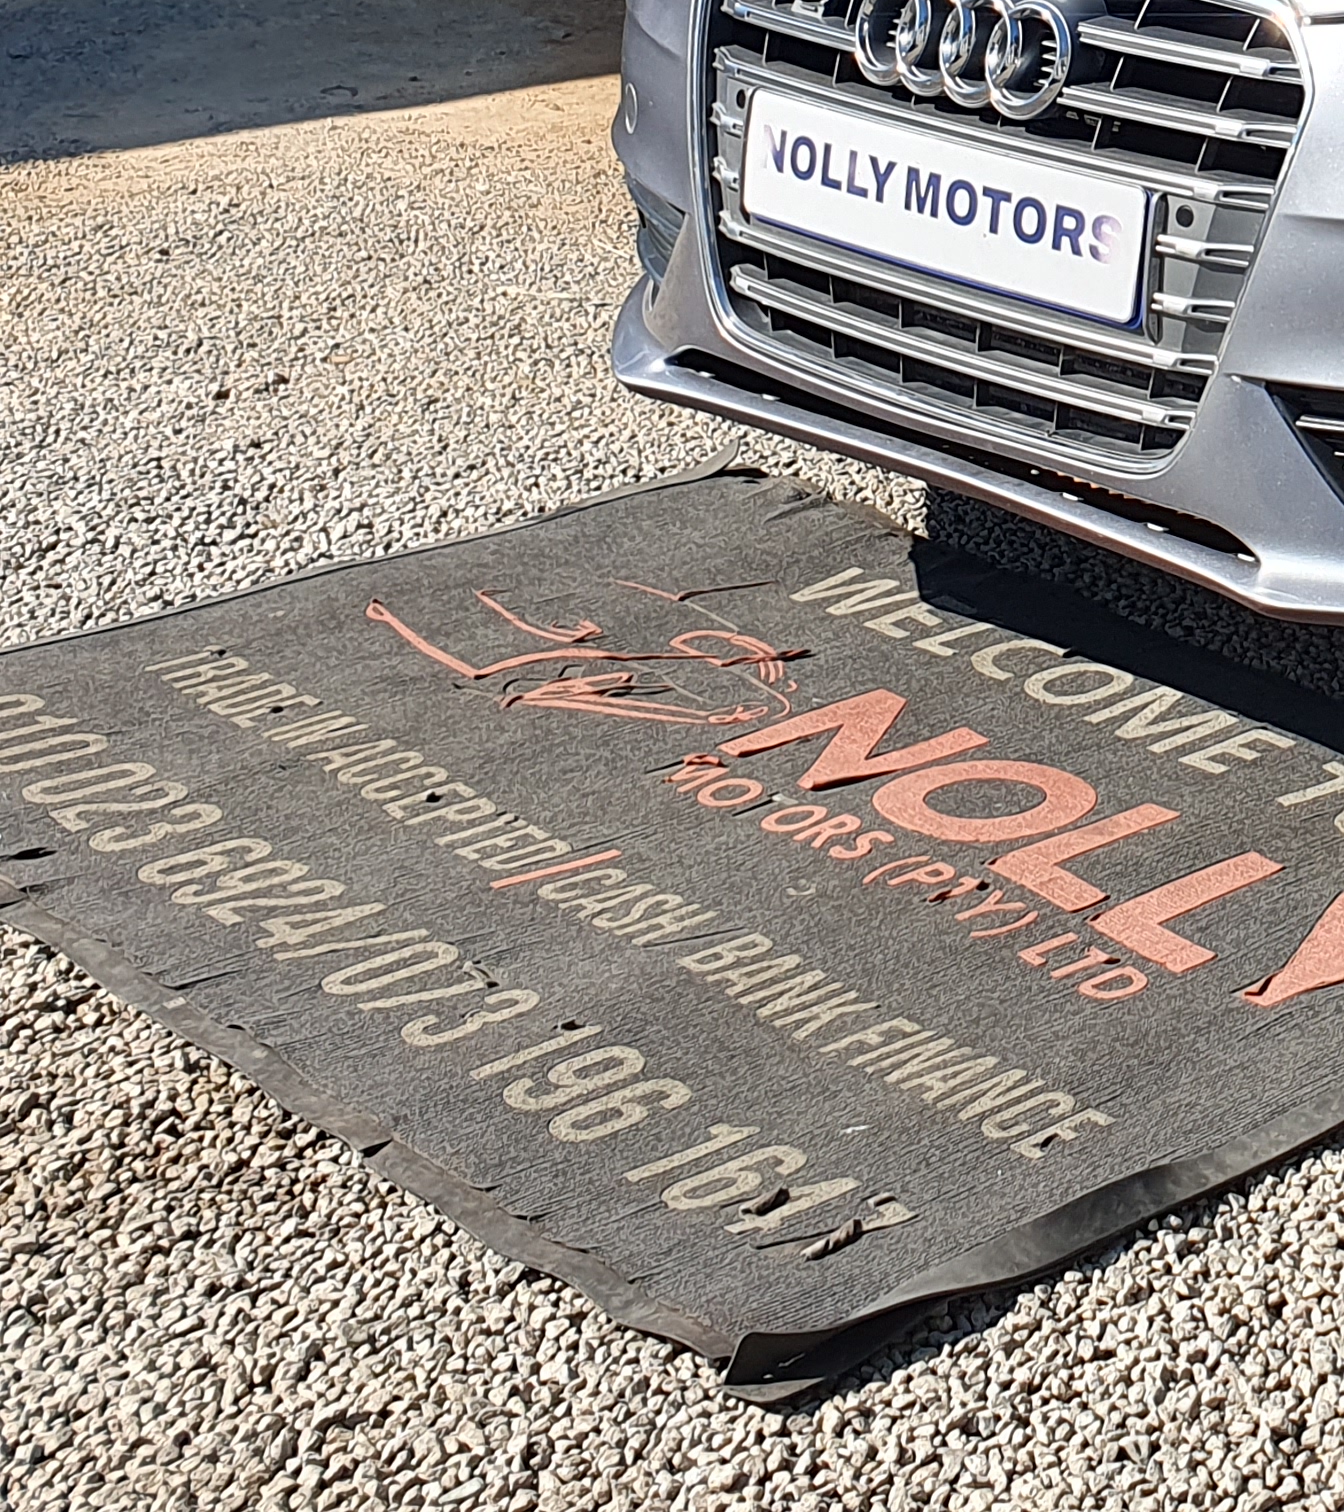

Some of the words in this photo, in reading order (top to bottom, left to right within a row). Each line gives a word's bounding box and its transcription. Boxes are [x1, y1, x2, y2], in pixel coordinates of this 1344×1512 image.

[764, 124, 897, 205] NOLLY
[903, 166, 1123, 264] MOTORS
[790, 567, 1297, 774] WELCOME
[22, 762, 223, 852] 023
[137, 838, 541, 1048] 6924/073
[469, 1024, 693, 1143] 196
[145, 643, 323, 729] TRADE
[263, 710, 370, 748] IN
[676, 931, 880, 1041] BANK
[817, 1016, 1117, 1159] FINANCE
[663, 753, 895, 859] MOORS
[1018, 932, 1149, 1001] LTD
